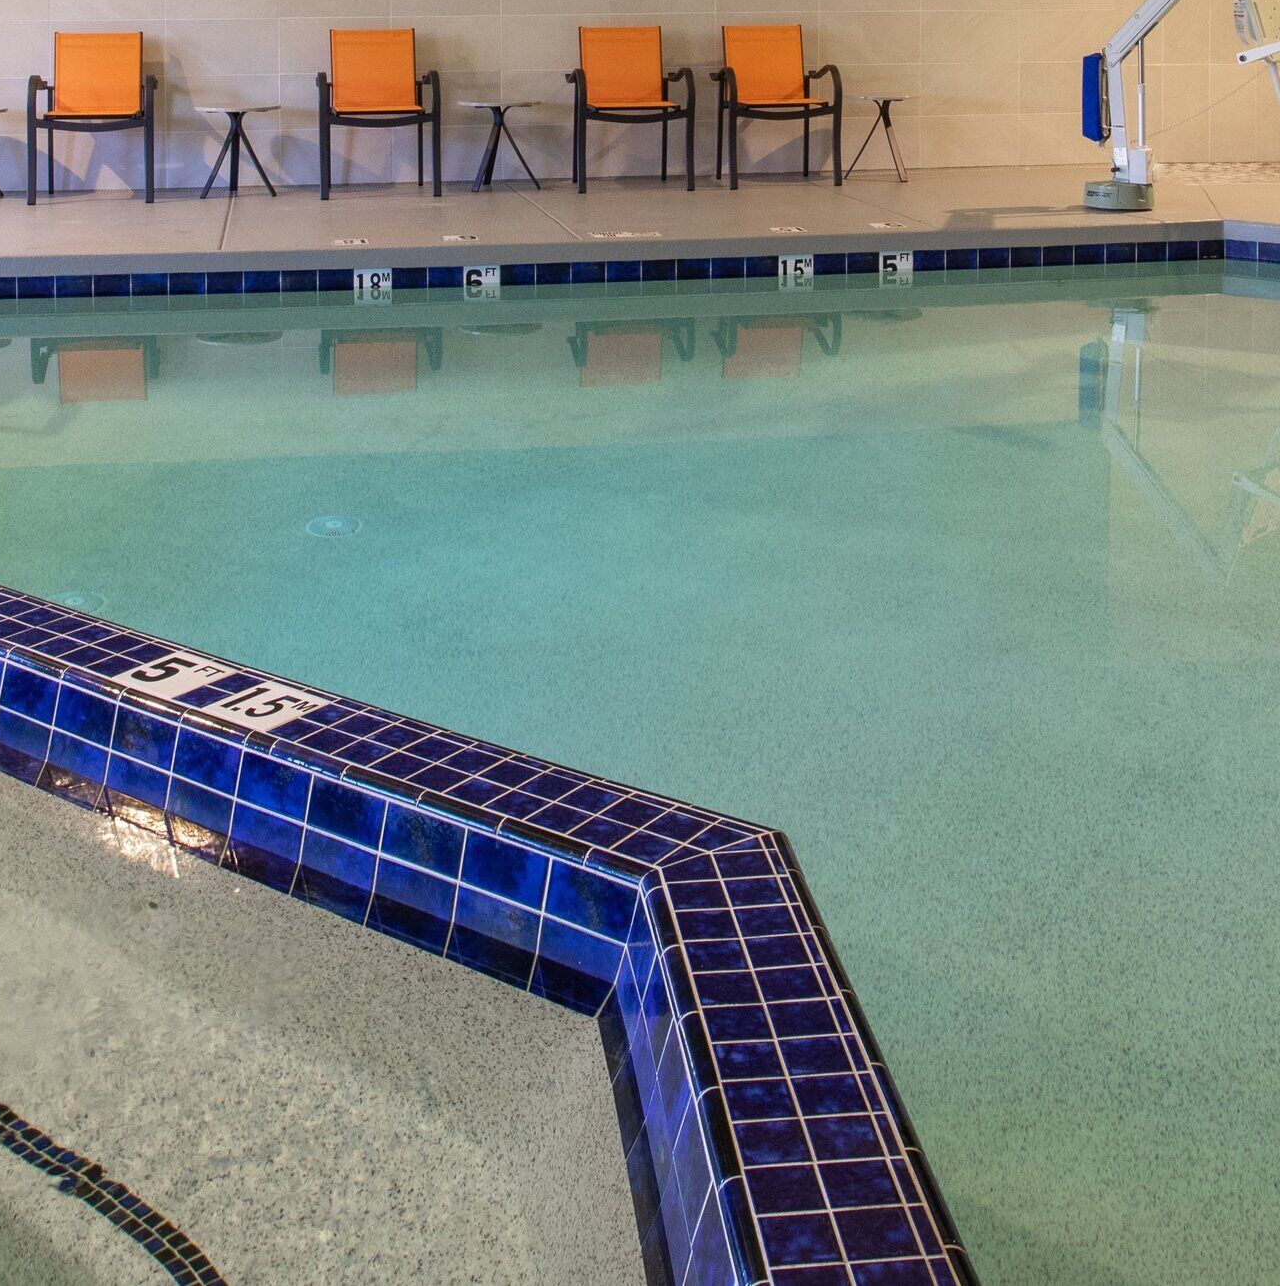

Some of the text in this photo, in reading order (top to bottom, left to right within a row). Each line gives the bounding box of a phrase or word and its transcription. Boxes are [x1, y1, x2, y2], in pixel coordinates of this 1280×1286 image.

[882, 253, 911, 272] 5 FT
[465, 267, 497, 286] 6 FT
[130, 656, 226, 683] 5 FT
